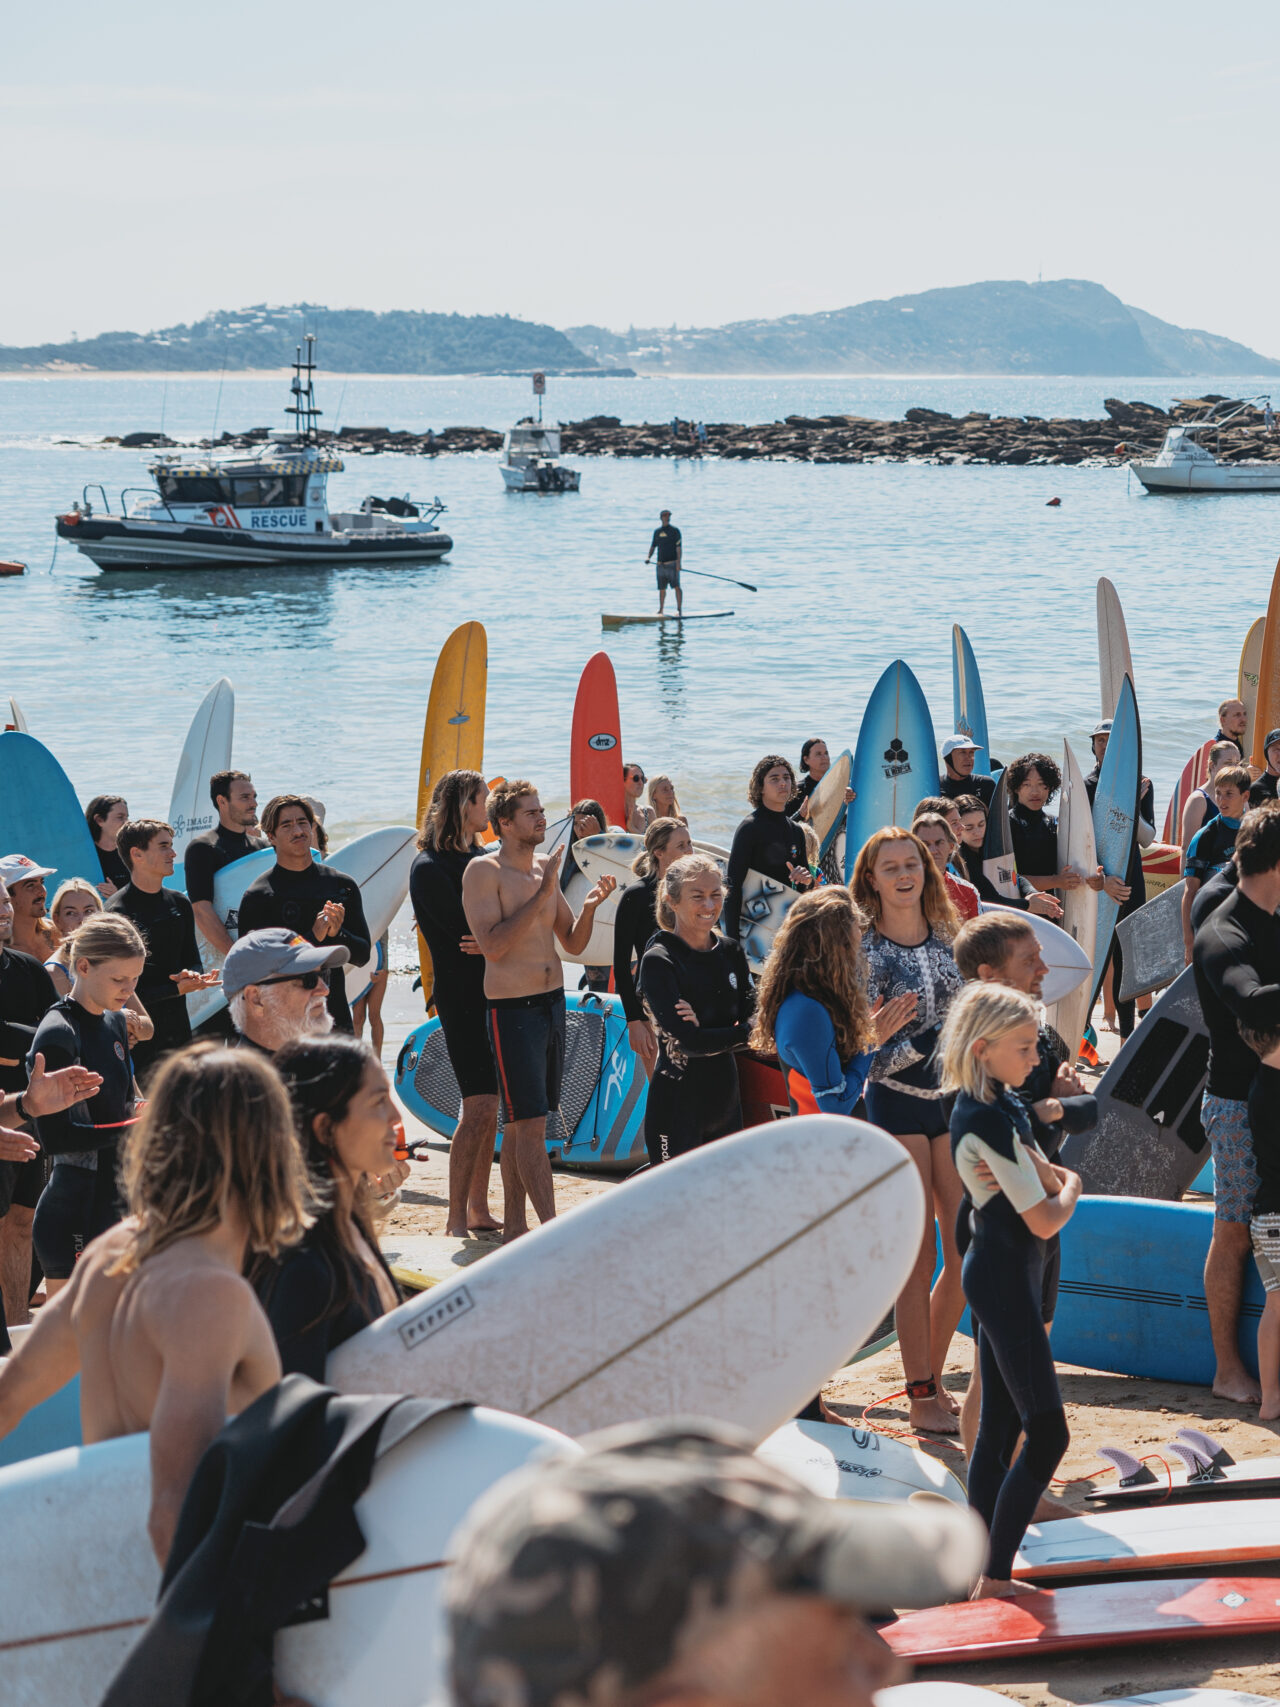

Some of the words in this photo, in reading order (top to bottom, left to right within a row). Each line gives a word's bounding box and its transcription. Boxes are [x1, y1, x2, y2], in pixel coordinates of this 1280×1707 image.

[251, 514, 307, 528] RESCUE
[595, 736, 610, 746] dmz
[187, 816, 213, 826] IMAGE
[408, 1296, 464, 1339] PEPPER
